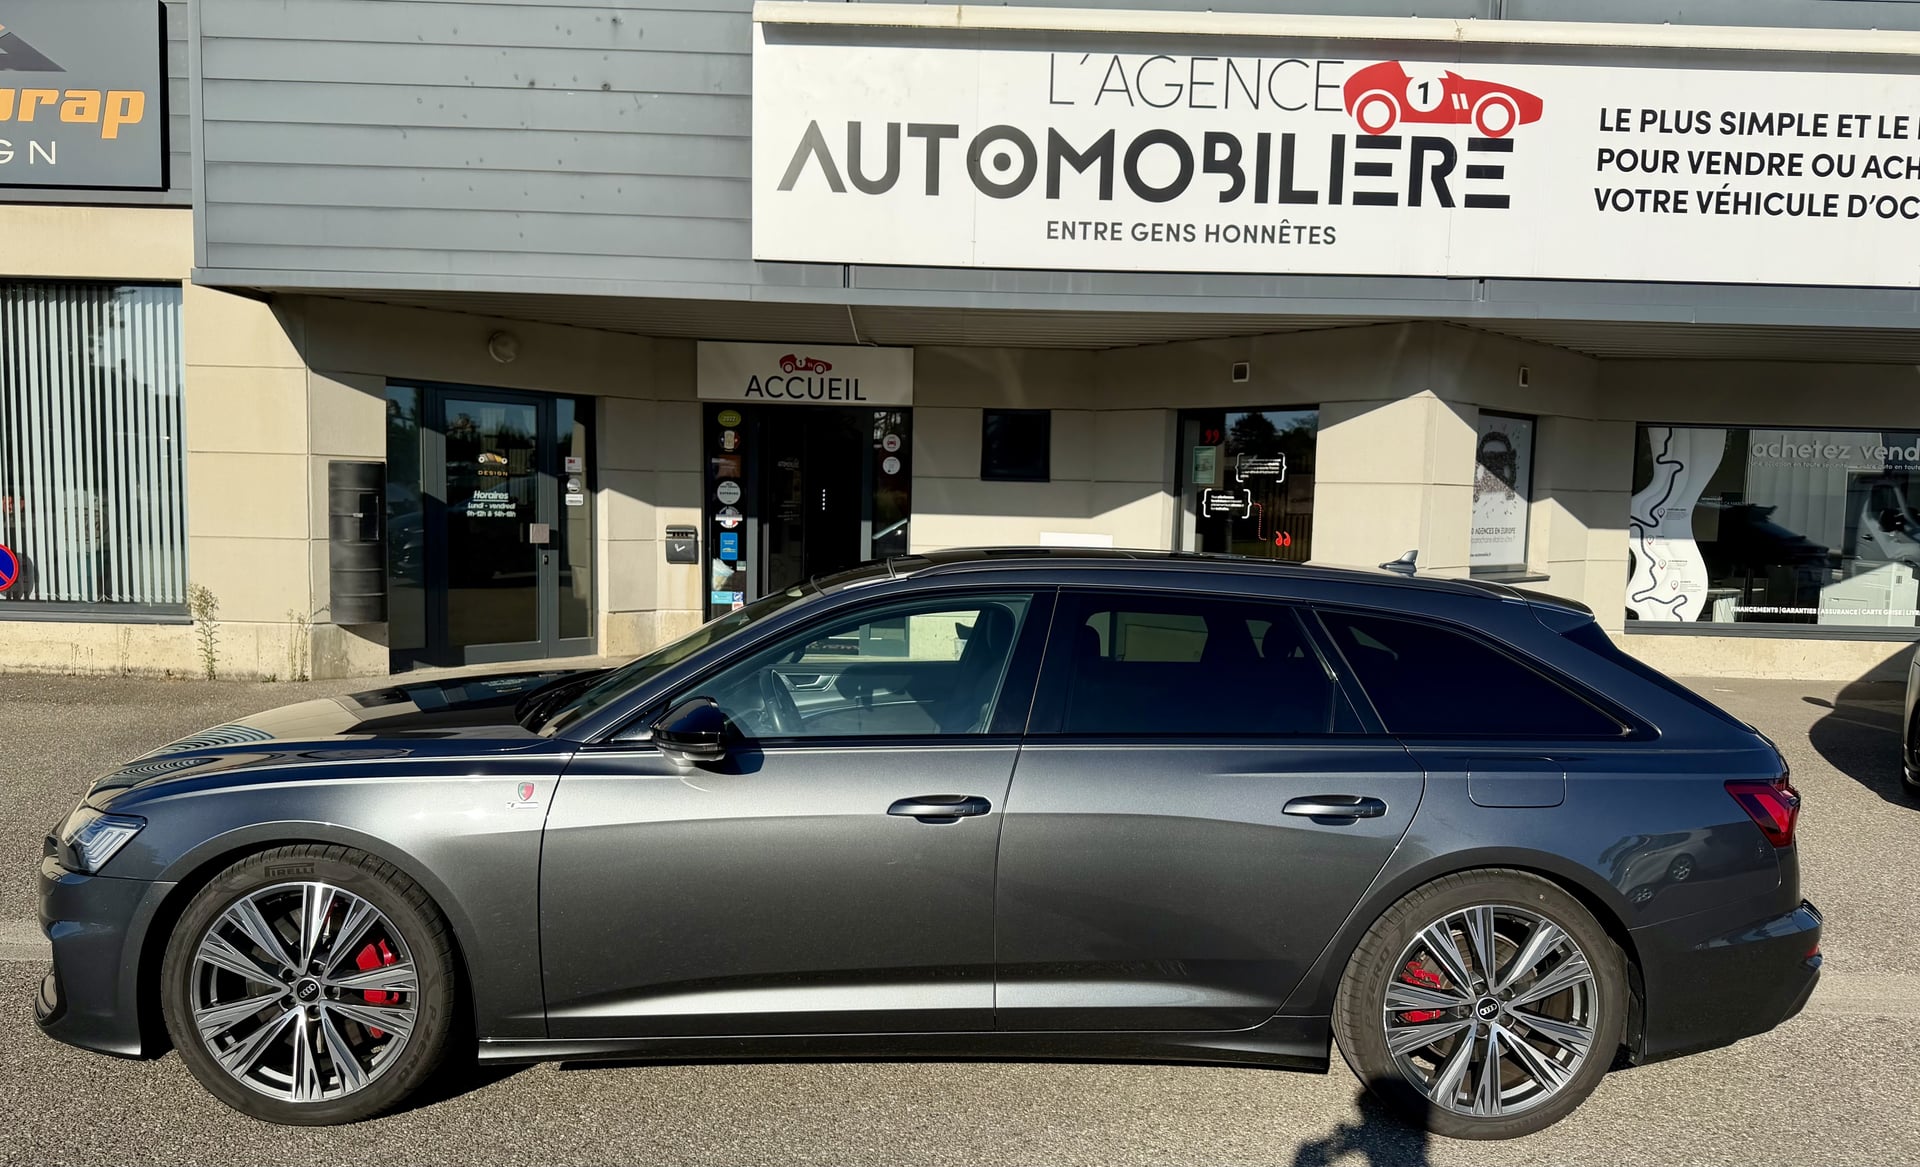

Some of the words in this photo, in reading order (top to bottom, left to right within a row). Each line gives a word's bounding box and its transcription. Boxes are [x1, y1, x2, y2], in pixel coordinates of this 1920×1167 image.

[1050, 53, 1344, 111] L'AGENCE
[1418, 81, 1429, 105] 1
[1599, 107, 1632, 133] LE
[1639, 108, 1712, 135] PLUS
[1719, 111, 1829, 138] SIMPLE
[1836, 114, 1872, 138] ET
[1877, 115, 1910, 140] LE
[1597, 147, 1680, 174] POUR
[1687, 150, 1804, 177] VENDRE
[1811, 153, 1856, 179] OU
[1861, 154, 1920, 180] ACH
[1594, 187, 1689, 214] VOTRE
[1696, 183, 1839, 217] VÉHICULE
[1847, 194, 1920, 220] D'OC
[1046, 221, 1123, 242] ENTRE
[1130, 222, 1196, 243] GENS
[1204, 219, 1337, 246] HONNÊTES
[745, 375, 867, 401] ACCUEIL
[1752, 434, 1851, 460] achetez
[1859, 438, 1920, 461] vend
[473, 489, 509, 499] Horaires
[1730, 606, 1779, 614] FINANCEMENTS
[264, 861, 315, 878] PIRELLI
